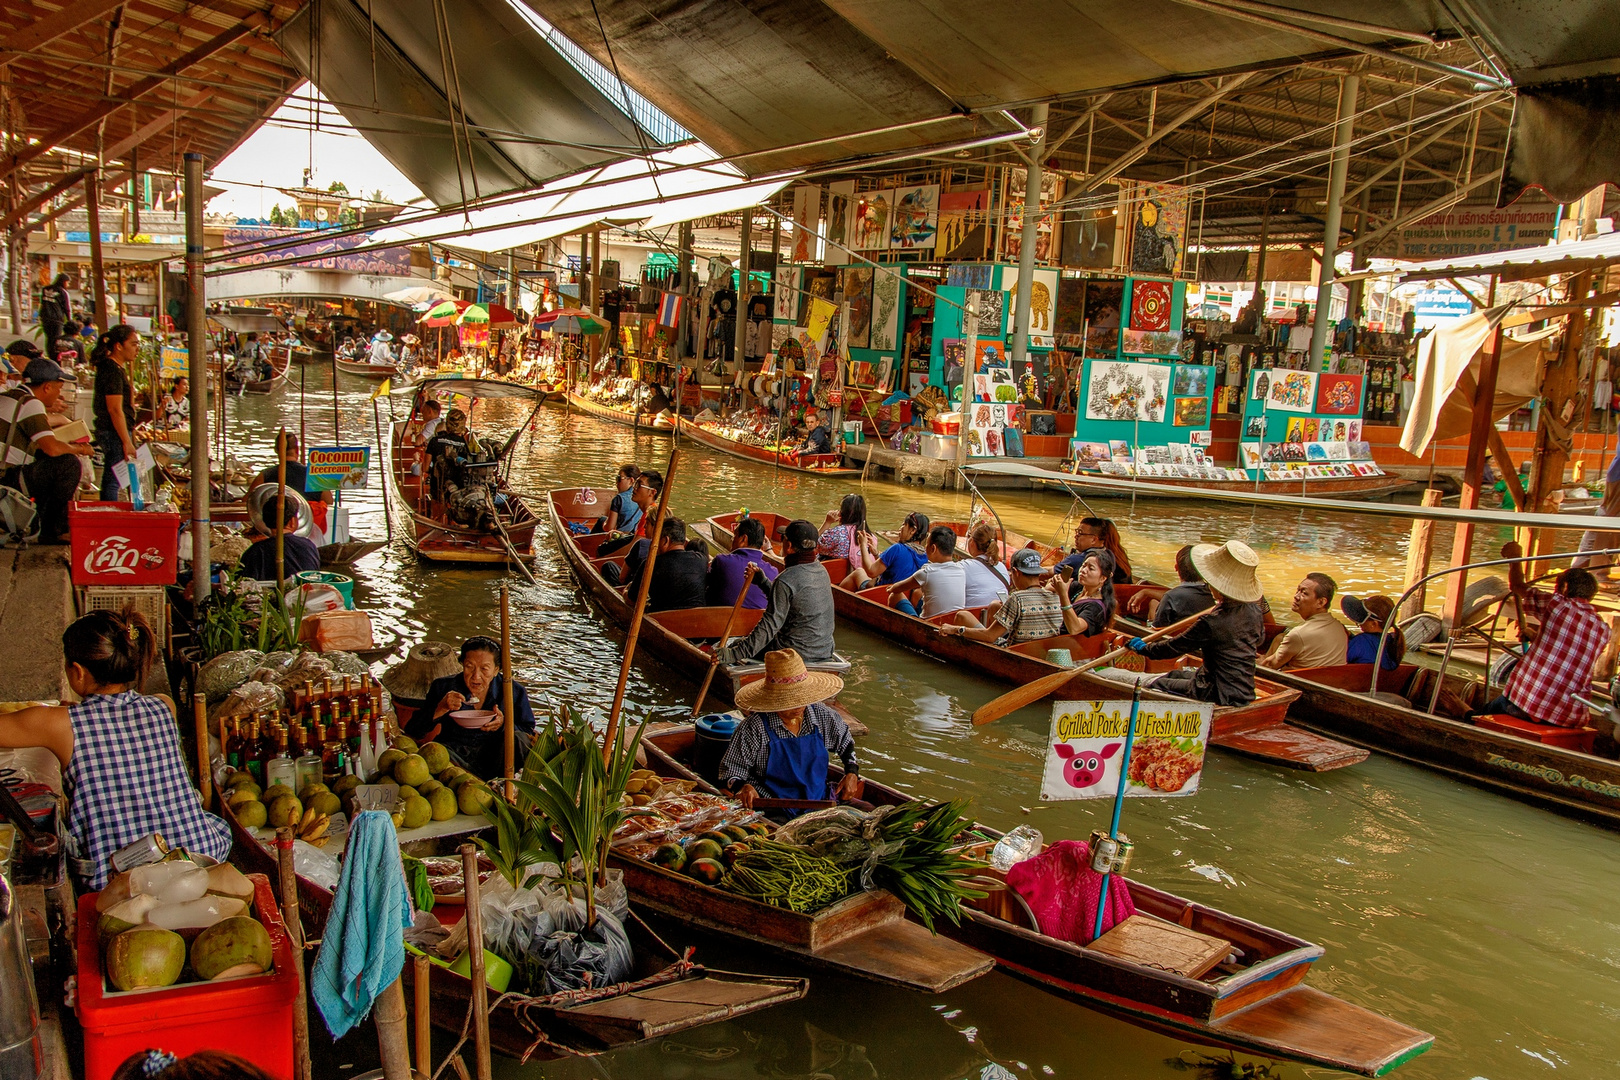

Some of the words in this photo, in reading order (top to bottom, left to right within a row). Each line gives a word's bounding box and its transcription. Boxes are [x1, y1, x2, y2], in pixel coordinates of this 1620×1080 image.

[1403, 243, 1426, 254] THE
[1429, 243, 1476, 254] CENTER
[310, 450, 364, 464] Coconut
[310, 465, 351, 475] Icecream
[1058, 712, 1094, 740] Grilled
[1096, 712, 1120, 736] Pork
[1122, 712, 1143, 736] ad
[1144, 712, 1172, 736] Fresh
[1174, 713, 1200, 736] Milk
